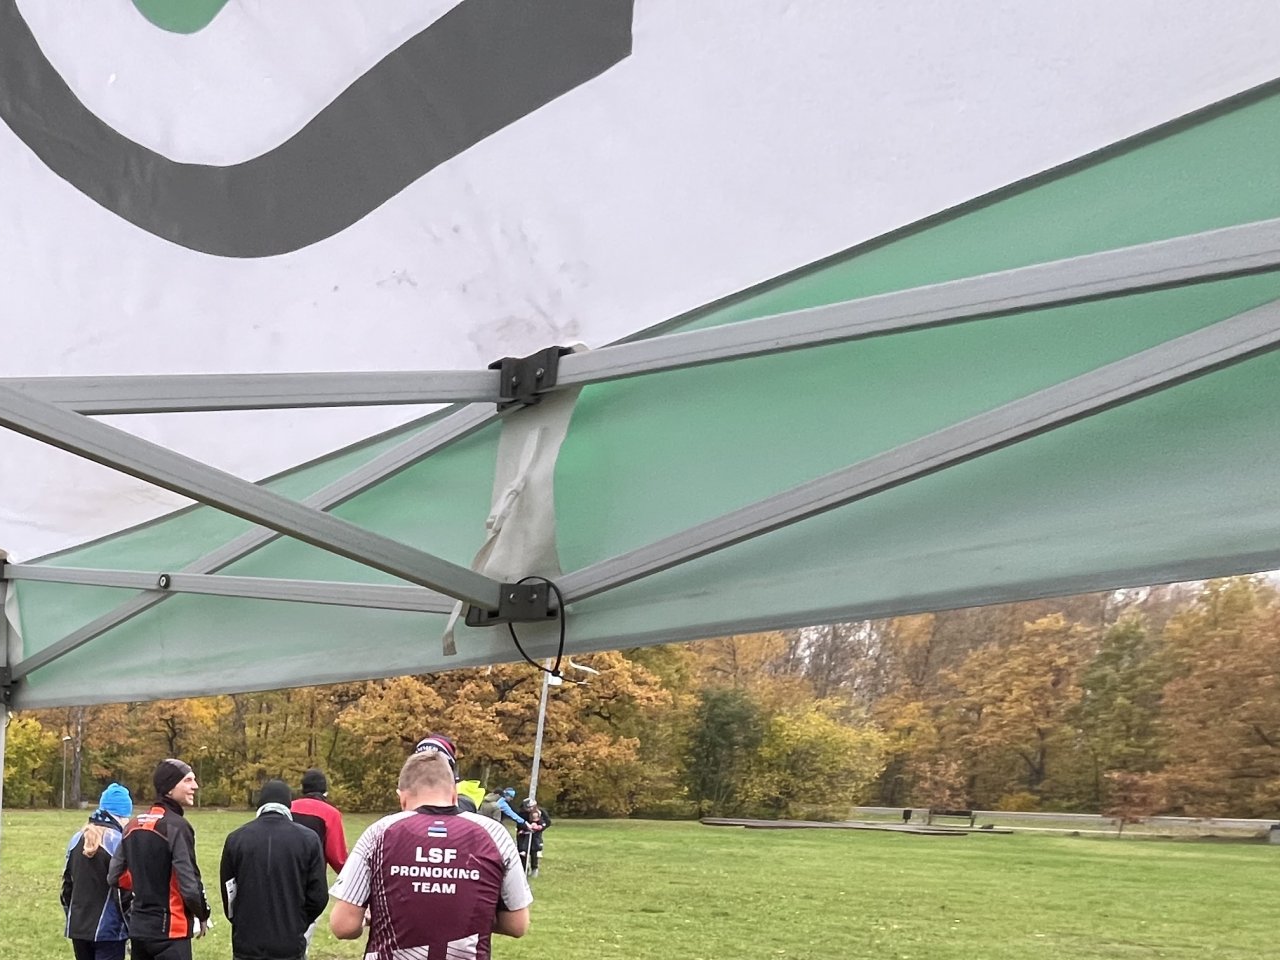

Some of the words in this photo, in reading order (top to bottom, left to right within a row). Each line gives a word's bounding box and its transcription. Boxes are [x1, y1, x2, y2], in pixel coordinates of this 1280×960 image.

[415, 846, 457, 864] LSF
[390, 865, 480, 880] PRONOKING
[412, 881, 456, 894] TEAM
